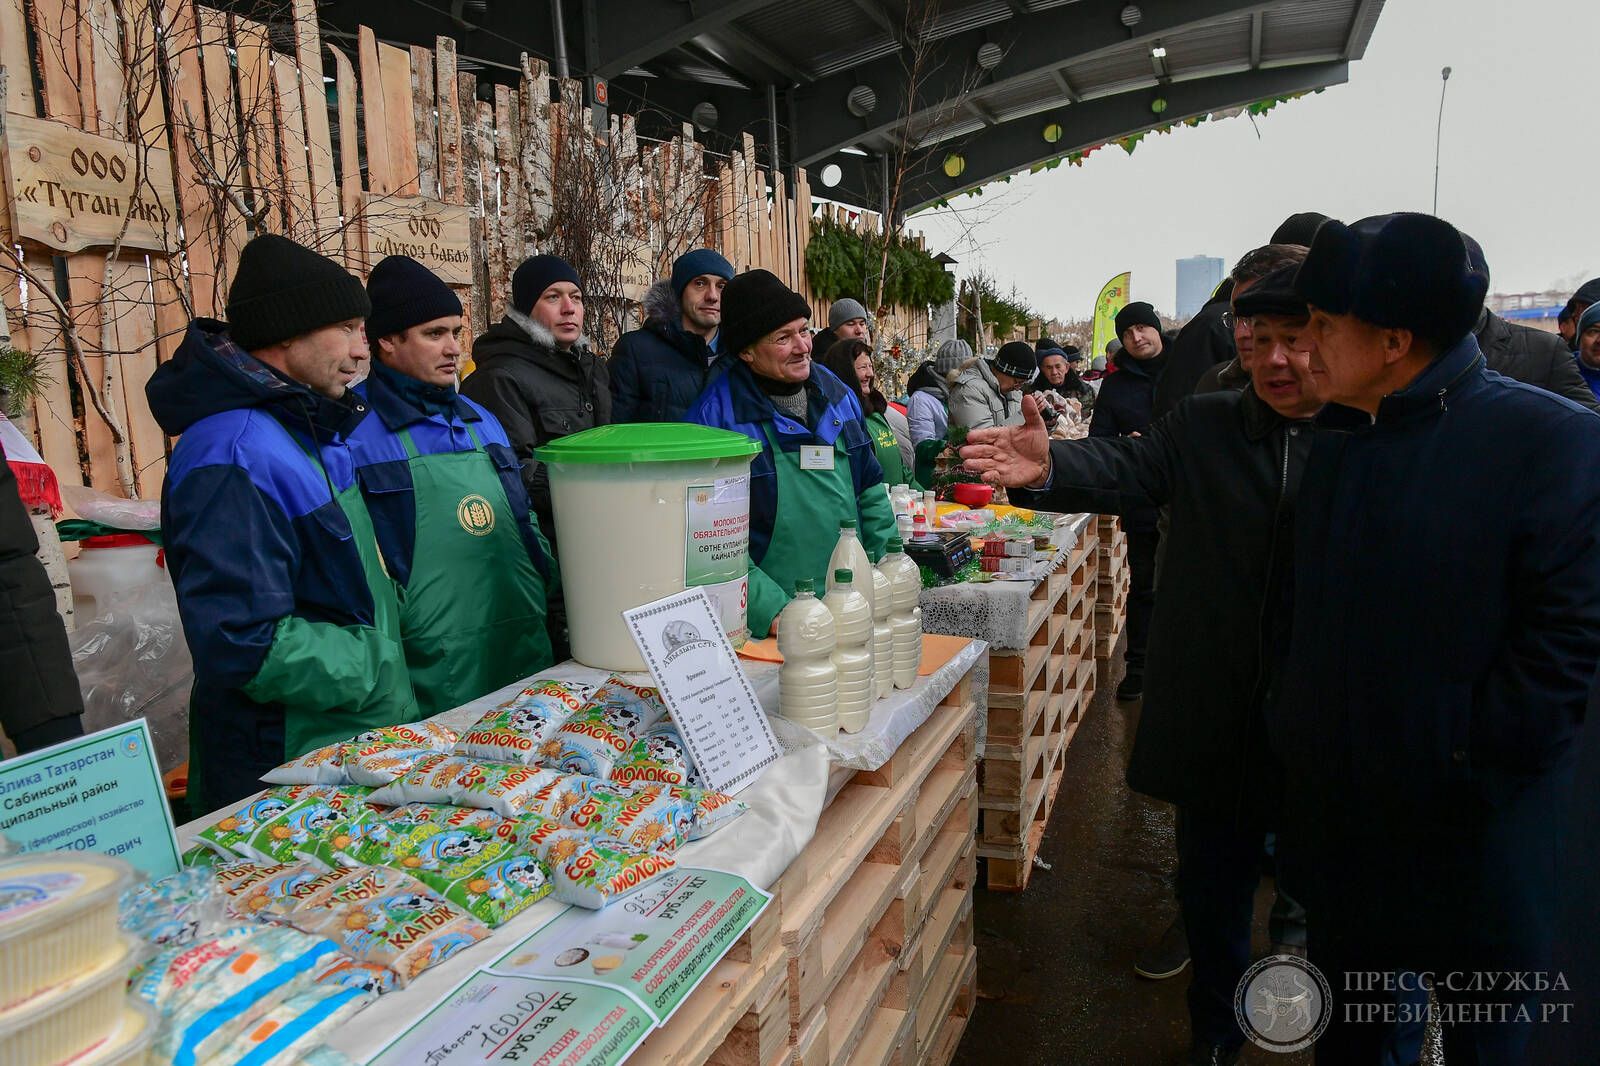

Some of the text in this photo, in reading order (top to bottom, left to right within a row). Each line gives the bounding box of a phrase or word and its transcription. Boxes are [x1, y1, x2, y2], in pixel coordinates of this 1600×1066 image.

[71, 147, 127, 183] ООО
[23, 179, 121, 219] «Туган
[407, 214, 441, 240] ООО
[466, 732, 532, 750] МОЛОКО
[559, 722, 627, 753] МОЛОКО
[45, 747, 116, 779] Татарстан
[610, 766, 682, 785] МОЛОКО
[4, 776, 78, 811] Сабинский
[81, 779, 119, 803] район
[28, 799, 145, 851] (фермерское) хозяйство
[571, 797, 603, 828] СӨТ
[55, 833, 97, 852] ТОВ
[565, 848, 600, 881] СӨТ
[388, 905, 460, 950] КАТЫК
[631, 899, 716, 983] МОЛОЧНЫЕ ПРОДУКЦИИ
[644, 885, 747, 995] СОБСТВЕННОГО ПРОИЗВОДСТВА
[549, 992, 579, 1012] КГ
